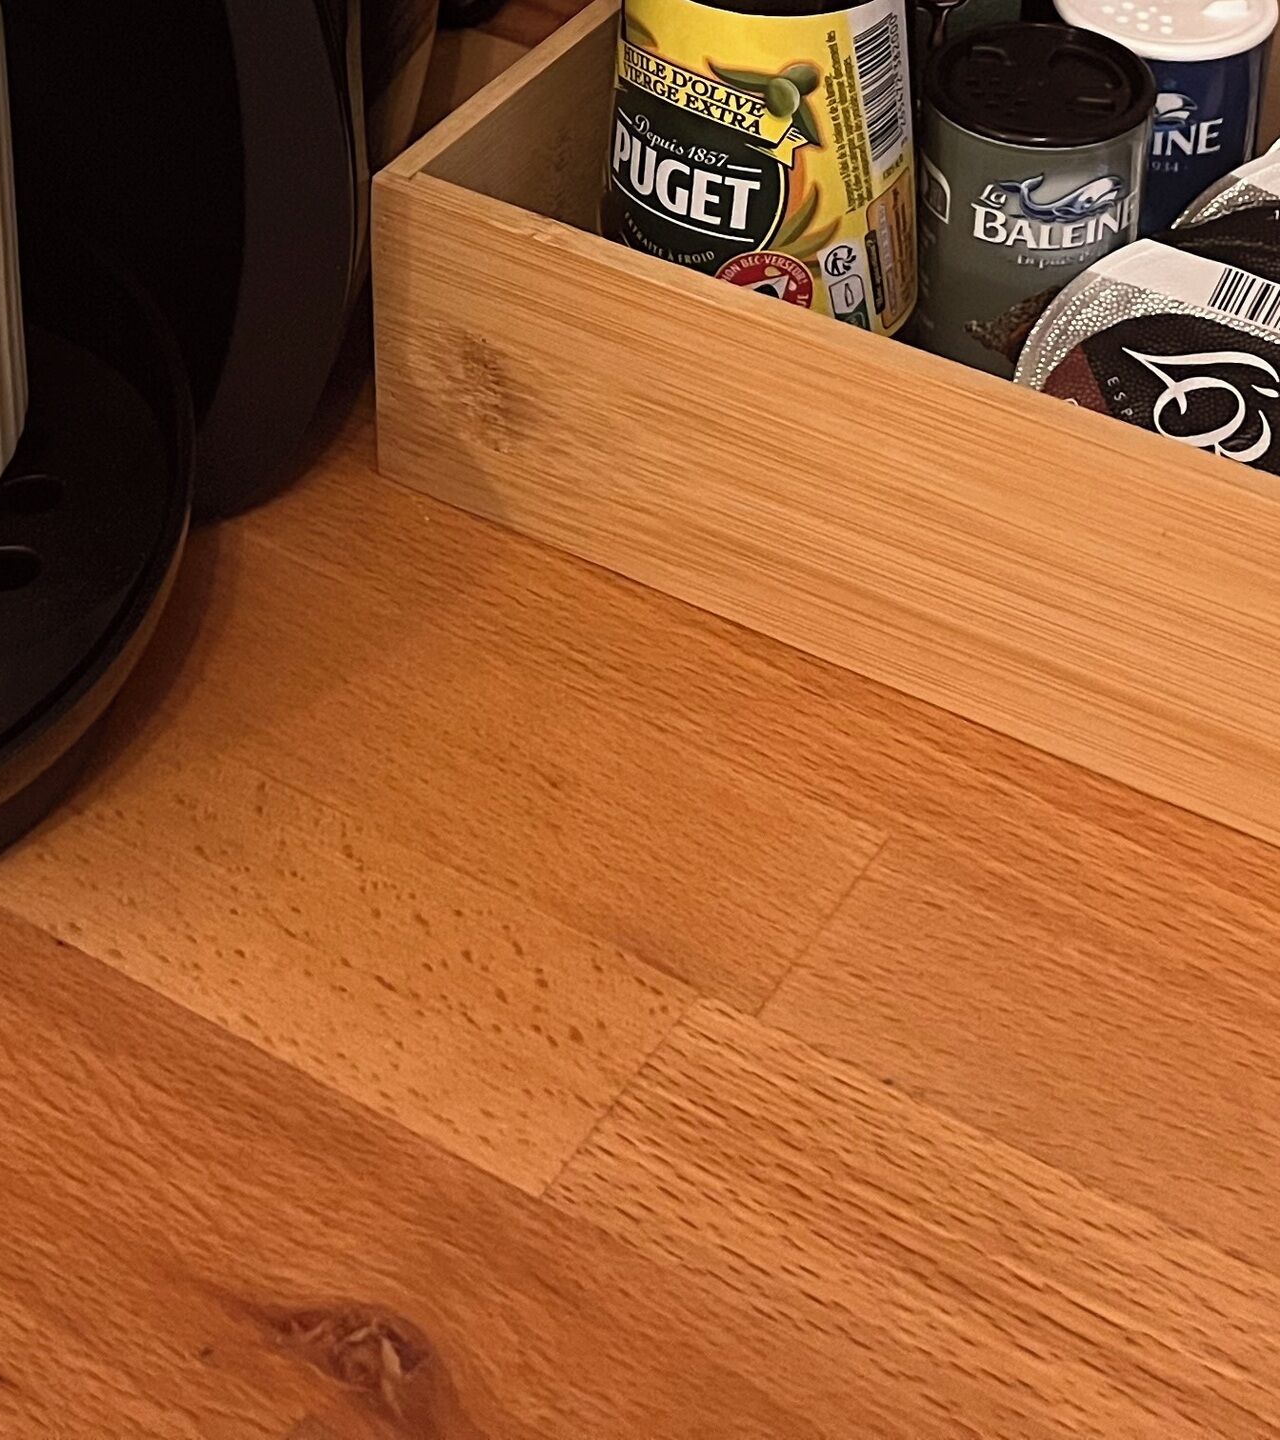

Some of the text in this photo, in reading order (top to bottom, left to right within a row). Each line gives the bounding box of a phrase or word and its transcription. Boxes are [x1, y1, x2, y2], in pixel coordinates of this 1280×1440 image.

[623, 63, 762, 136] VIERGE EXTRA
[624, 45, 766, 120] HUILE D'OLIVE
[632, 113, 730, 168] Depuis 1857
[612, 118, 762, 231] PUGET
[979, 183, 1008, 209] La
[971, 193, 1139, 250] BALEINE
[677, 250, 716, 265] FROID
